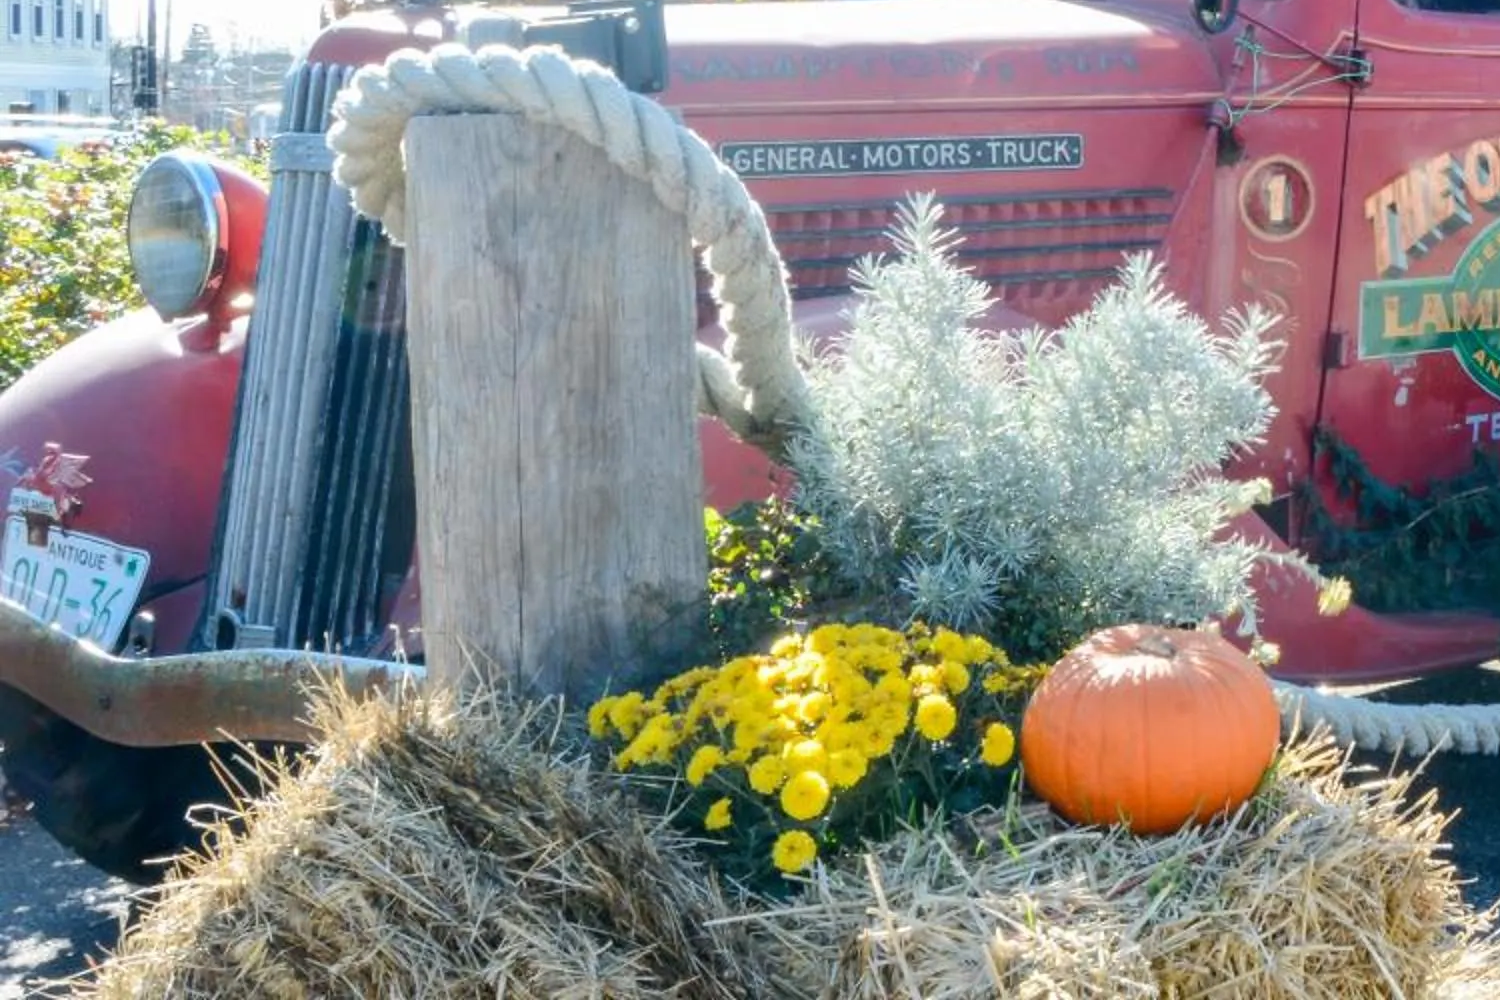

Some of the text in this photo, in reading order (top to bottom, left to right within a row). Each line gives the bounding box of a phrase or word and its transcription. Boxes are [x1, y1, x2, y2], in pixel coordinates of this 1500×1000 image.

[731, 139, 1074, 173] GENERAL MOTORS TRUCK
[1267, 173, 1288, 222] 1
[1364, 151, 1466, 278] THE
[48, 540, 107, 571] ANTIQUE
